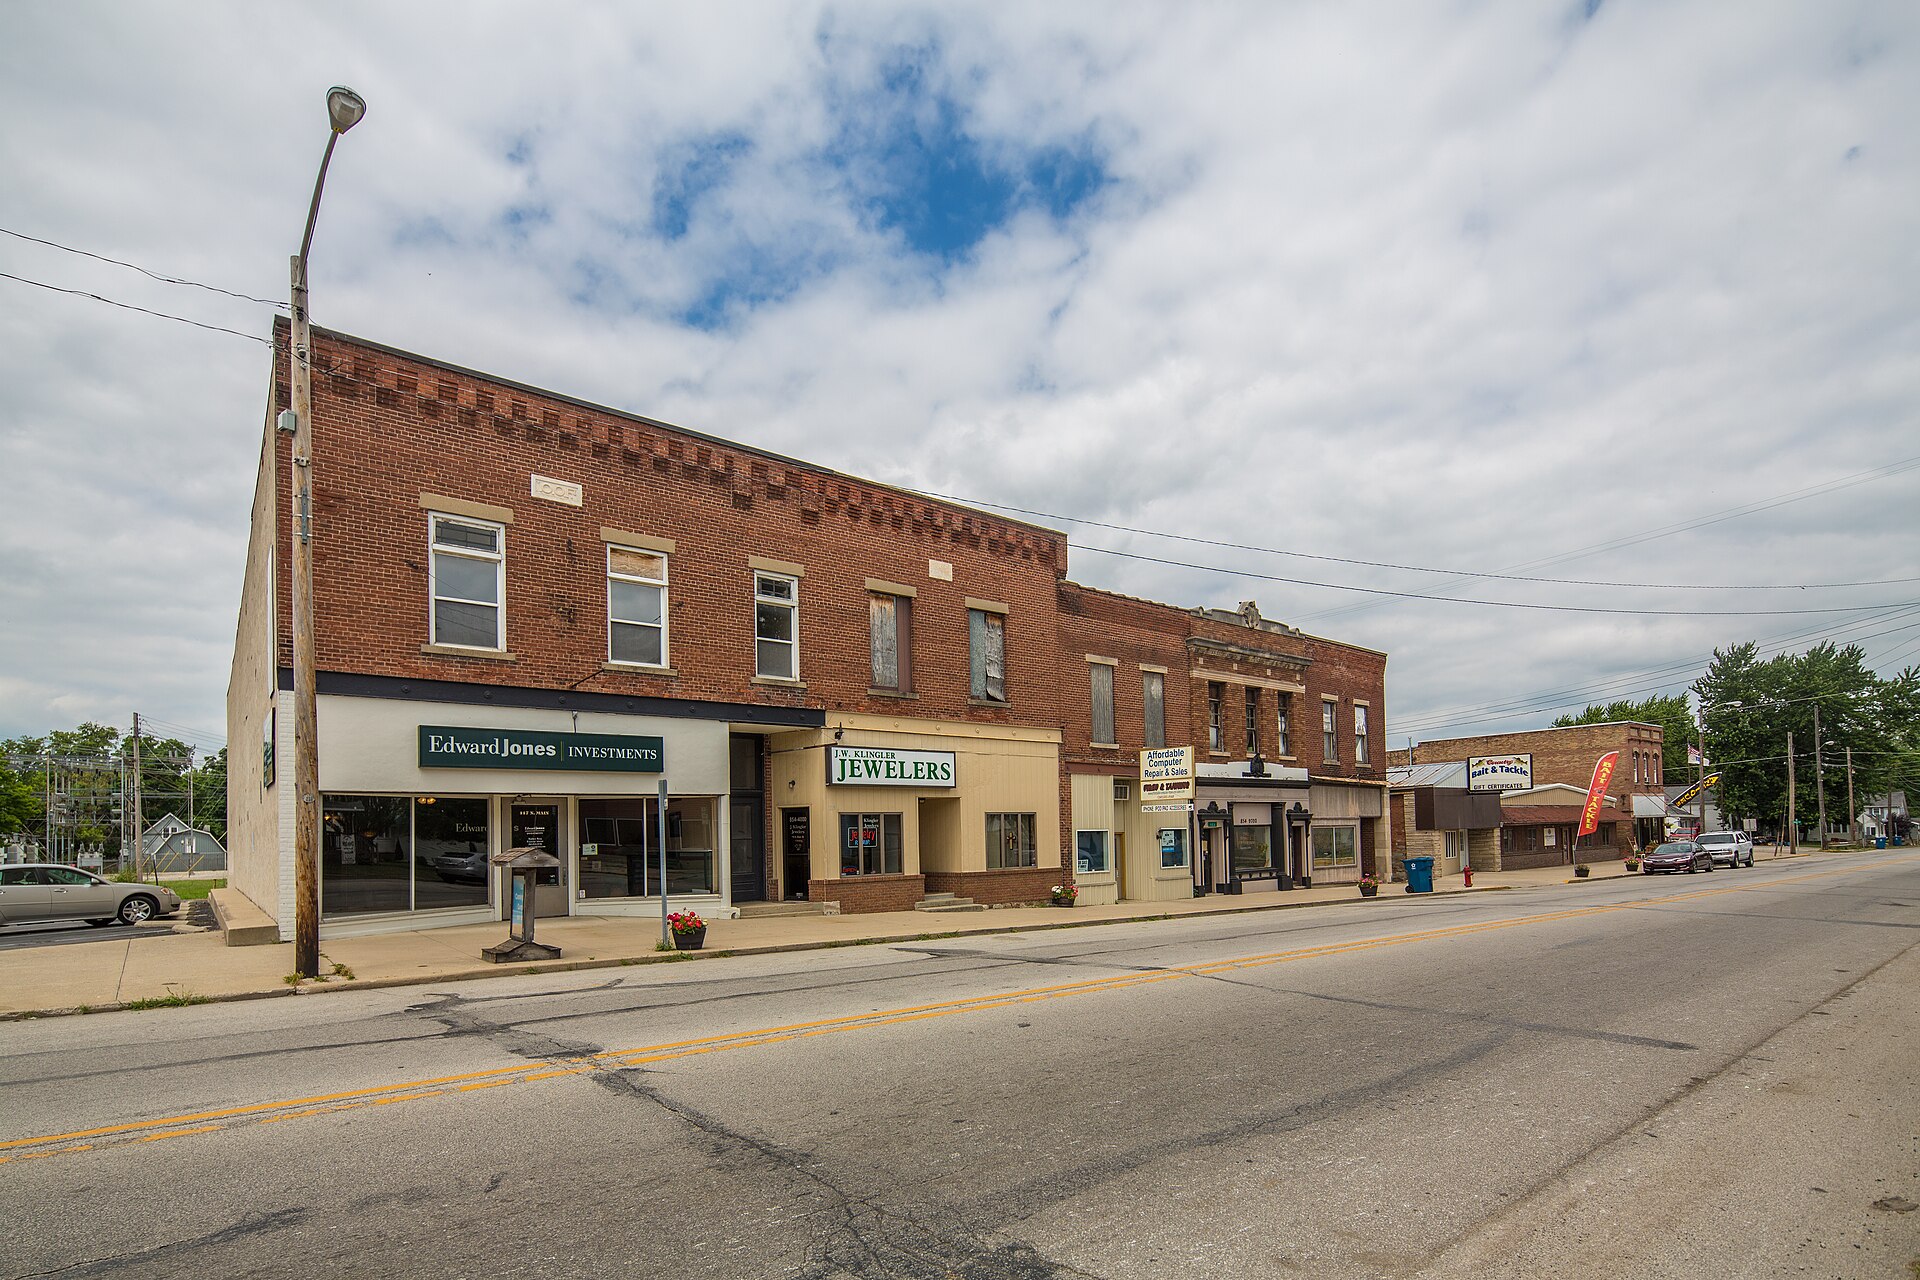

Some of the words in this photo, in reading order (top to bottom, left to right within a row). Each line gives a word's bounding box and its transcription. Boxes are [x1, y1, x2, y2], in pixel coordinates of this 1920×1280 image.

[568, 746, 657, 760] INVESTMENTS
[854, 750, 896, 760] KLINGLER
[1147, 749, 1185, 760] Affordable
[836, 758, 951, 782] JEWELERS
[1148, 758, 1182, 769] Computer
[1144, 769, 1164, 779] Repair
[1164, 768, 1170, 777] &
[1171, 767, 1188, 776] Sales
[1472, 767, 1489, 778] Bait
[1490, 765, 1498, 773] &
[1499, 765, 1529, 776] Tackle
[1599, 761, 1612, 784] BAIT
[1585, 795, 1600, 829] TACKLE
[849, 829, 876, 842] Jeelry
